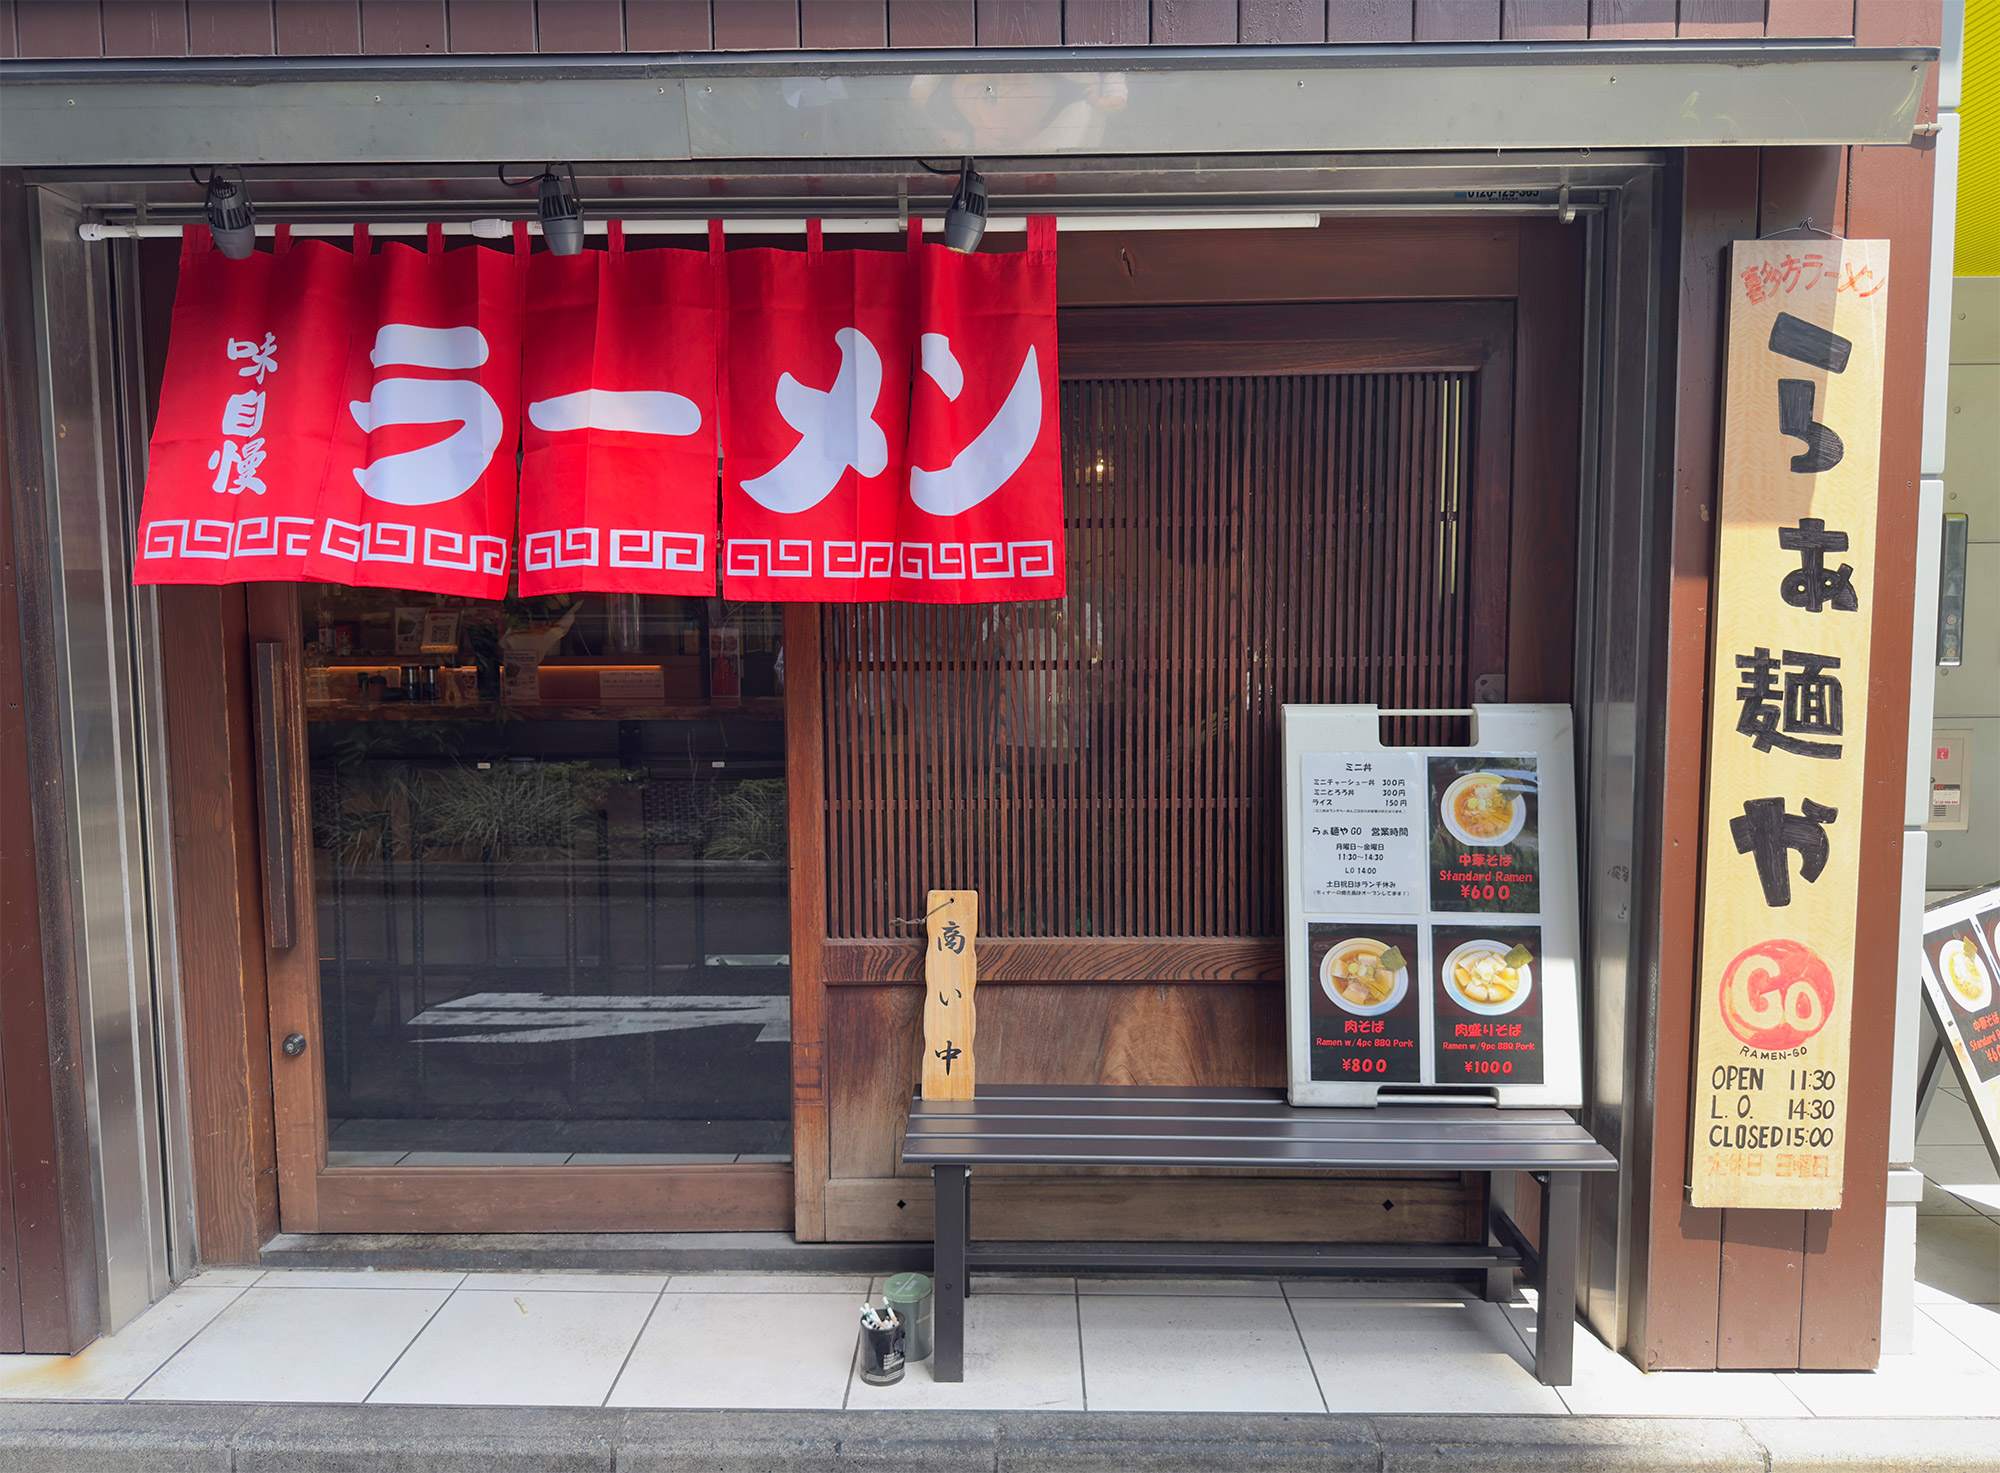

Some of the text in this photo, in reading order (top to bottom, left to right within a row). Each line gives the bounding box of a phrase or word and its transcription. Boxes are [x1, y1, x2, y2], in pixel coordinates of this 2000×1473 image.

[1740, 254, 1886, 306] 喜多方ラーメン
[208, 331, 279, 495] 味自慢
[349, 322, 1042, 516] ラーメン
[1345, 762, 1373, 772] ミニ丼
[1382, 789, 1406, 797] 300円
[1371, 827, 1409, 837] 営業時間
[1459, 853, 1513, 867] 中華そば
[1357, 867, 1377, 875] 14:00
[1440, 870, 1533, 882] Standard Ramen
[1461, 884, 1510, 900] ¥600
[934, 921, 966, 1076] 商い中
[1344, 1020, 1384, 1034] 肉そば
[1455, 1023, 1522, 1037] 肉盛りそば
[1316, 1037, 1342, 1046] Ramen
[1374, 1038, 1391, 1047] BBQ
[1393, 1039, 1414, 1048] Pork
[1442, 1041, 1468, 1050] Ramen
[1497, 1042, 1514, 1050] BBQ
[1516, 1042, 1535, 1050] Pork
[1740, 1045, 1808, 1061] RAMEN-GO
[1342, 1058, 1387, 1073] ¥800
[1464, 1061, 1513, 1074] ¥1000
[1711, 1065, 1836, 1091] OPEN 11:30
[1788, 1099, 1835, 1120] 14:30
[1709, 1124, 1834, 1149] CLOSED 15:00
